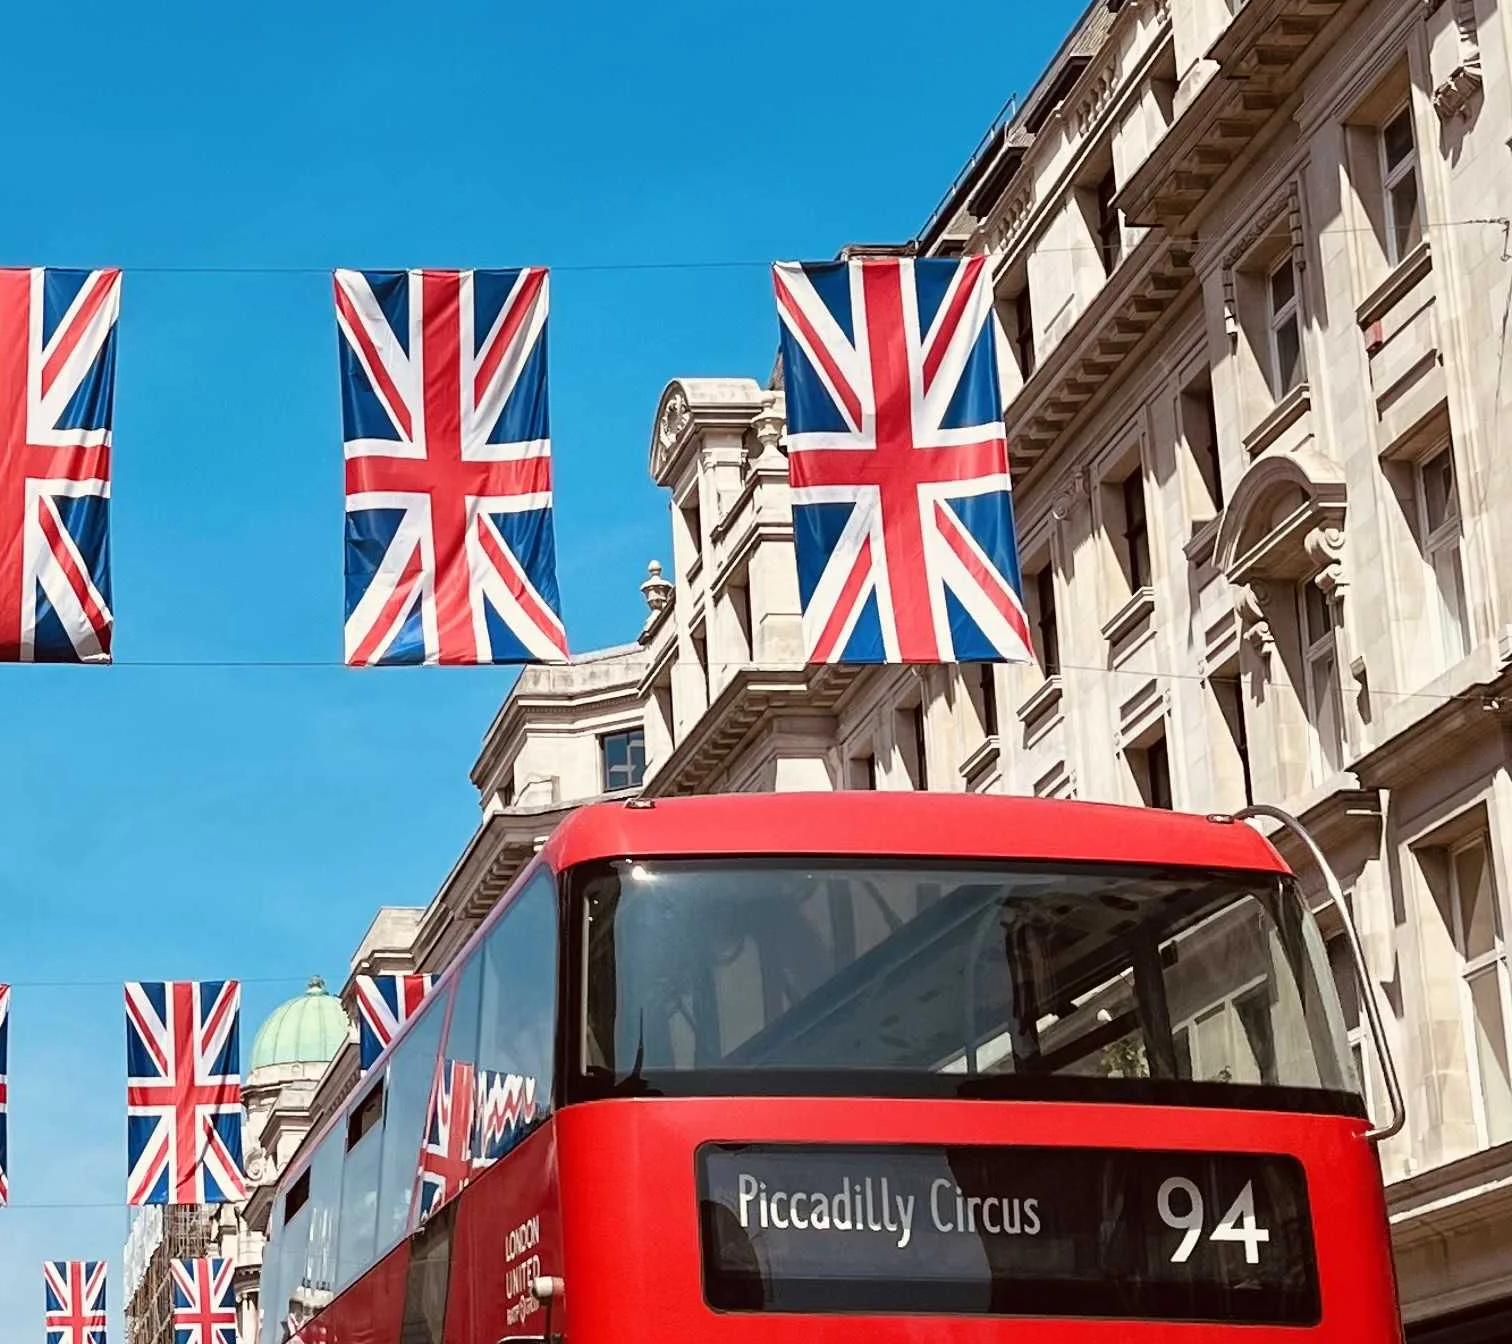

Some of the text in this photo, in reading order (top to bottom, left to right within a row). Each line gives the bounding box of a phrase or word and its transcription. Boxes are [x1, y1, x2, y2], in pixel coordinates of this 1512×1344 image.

[505, 1215, 540, 1263] LONDON
[738, 1173, 1042, 1249] Piccadilly Circus
[1157, 1176, 1270, 1264] 94
[506, 1254, 540, 1300] UNITED
